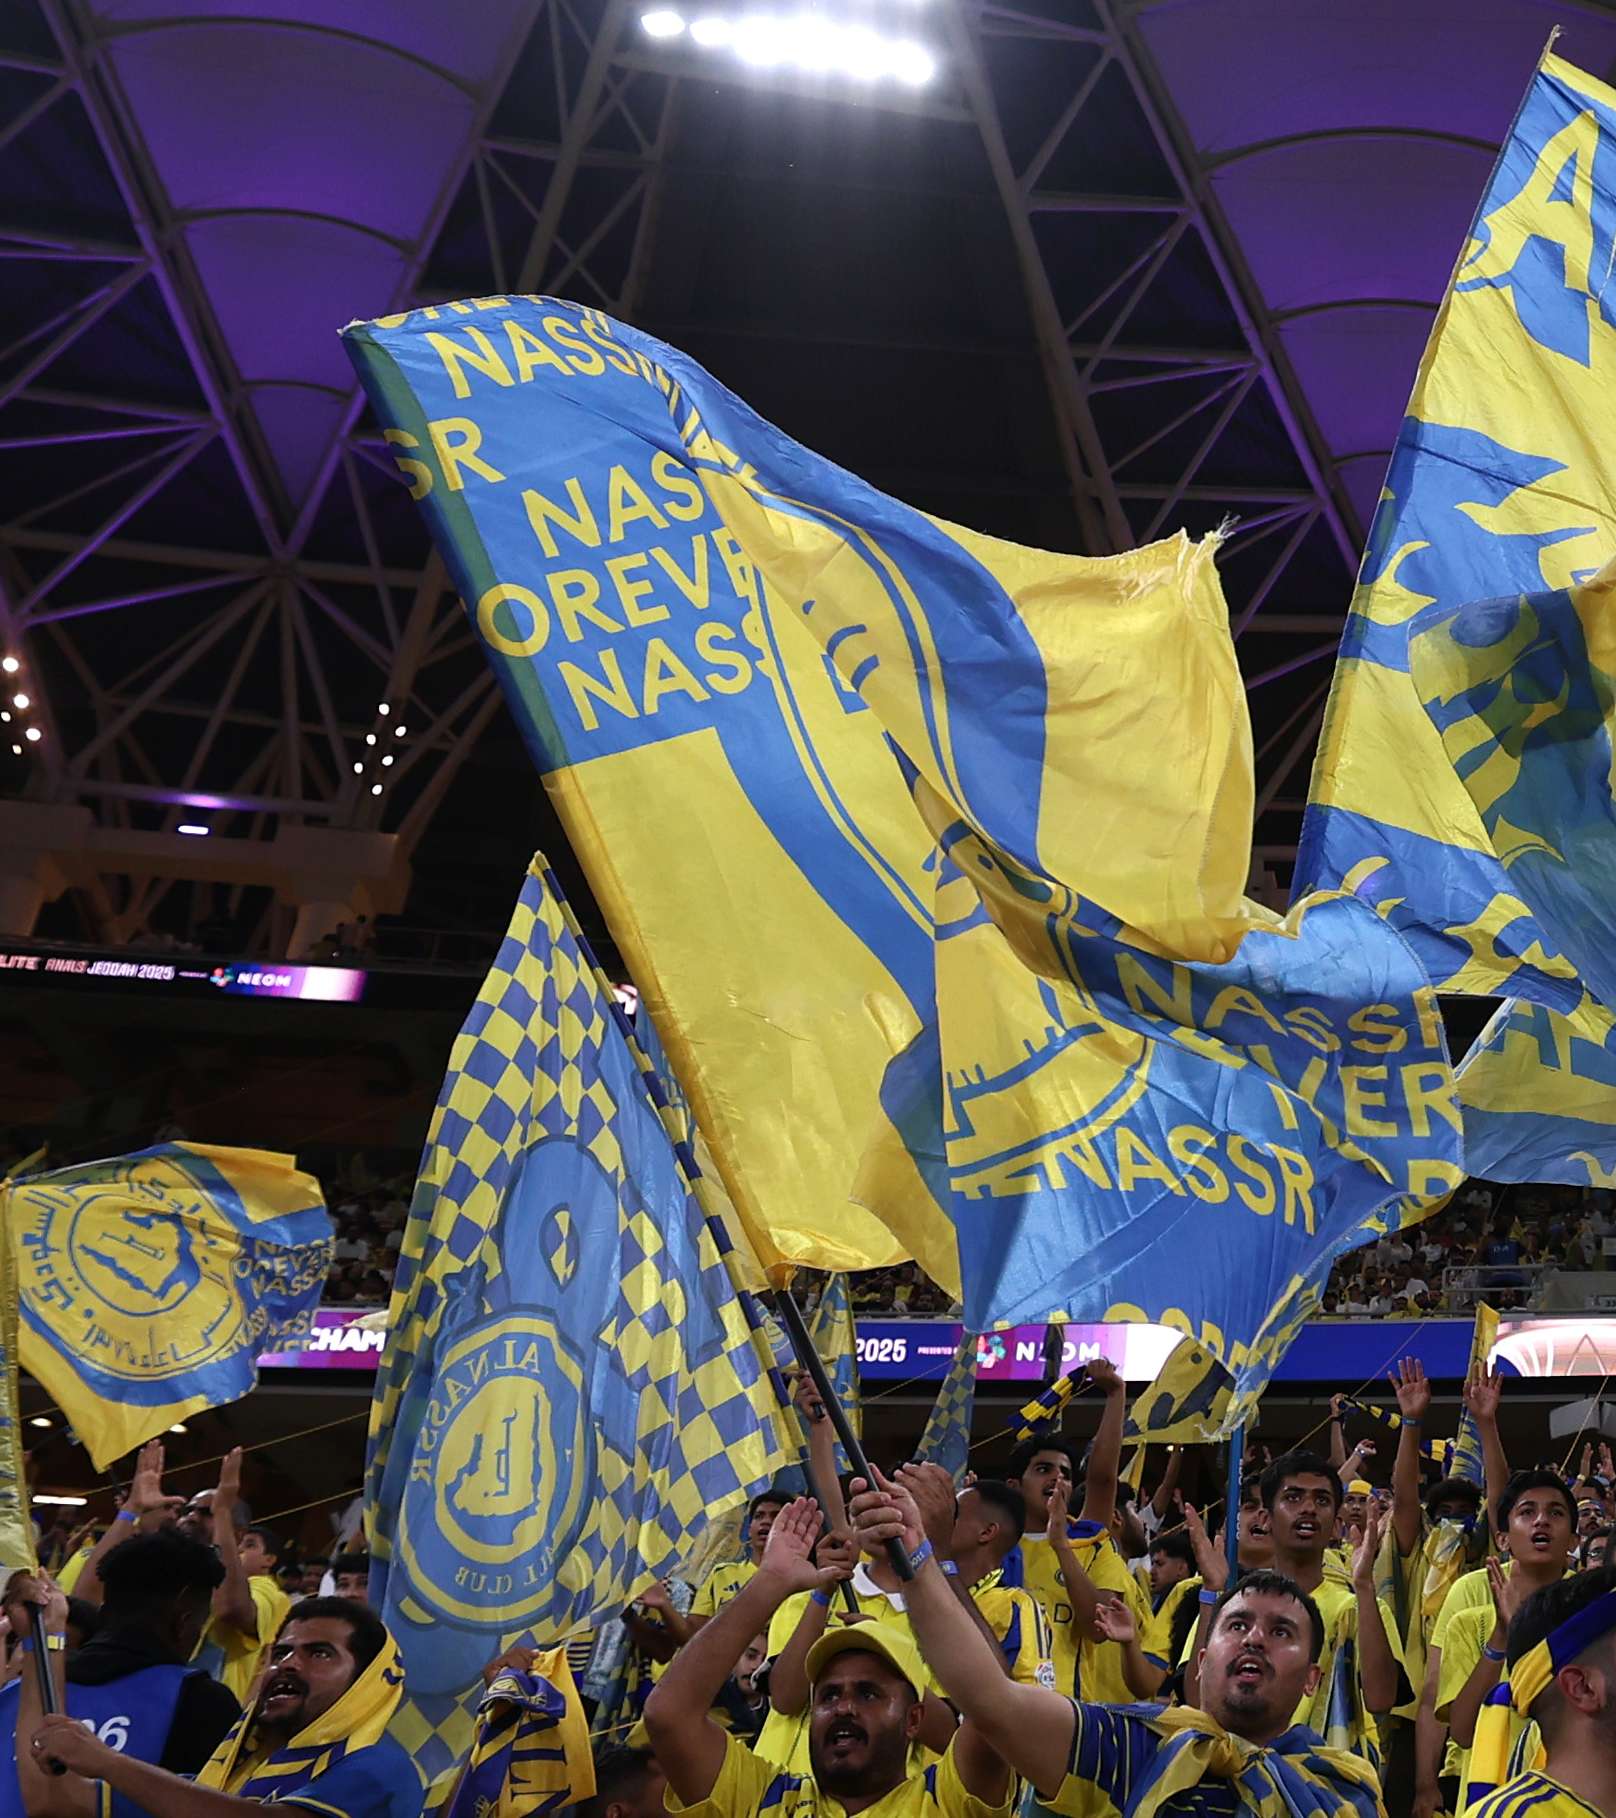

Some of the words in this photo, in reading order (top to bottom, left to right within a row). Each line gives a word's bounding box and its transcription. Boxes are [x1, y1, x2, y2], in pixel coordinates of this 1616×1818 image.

[0, 954, 40, 970] LITE
[237, 972, 292, 987] NEOM
[1015, 1341, 1101, 1362] NOM
